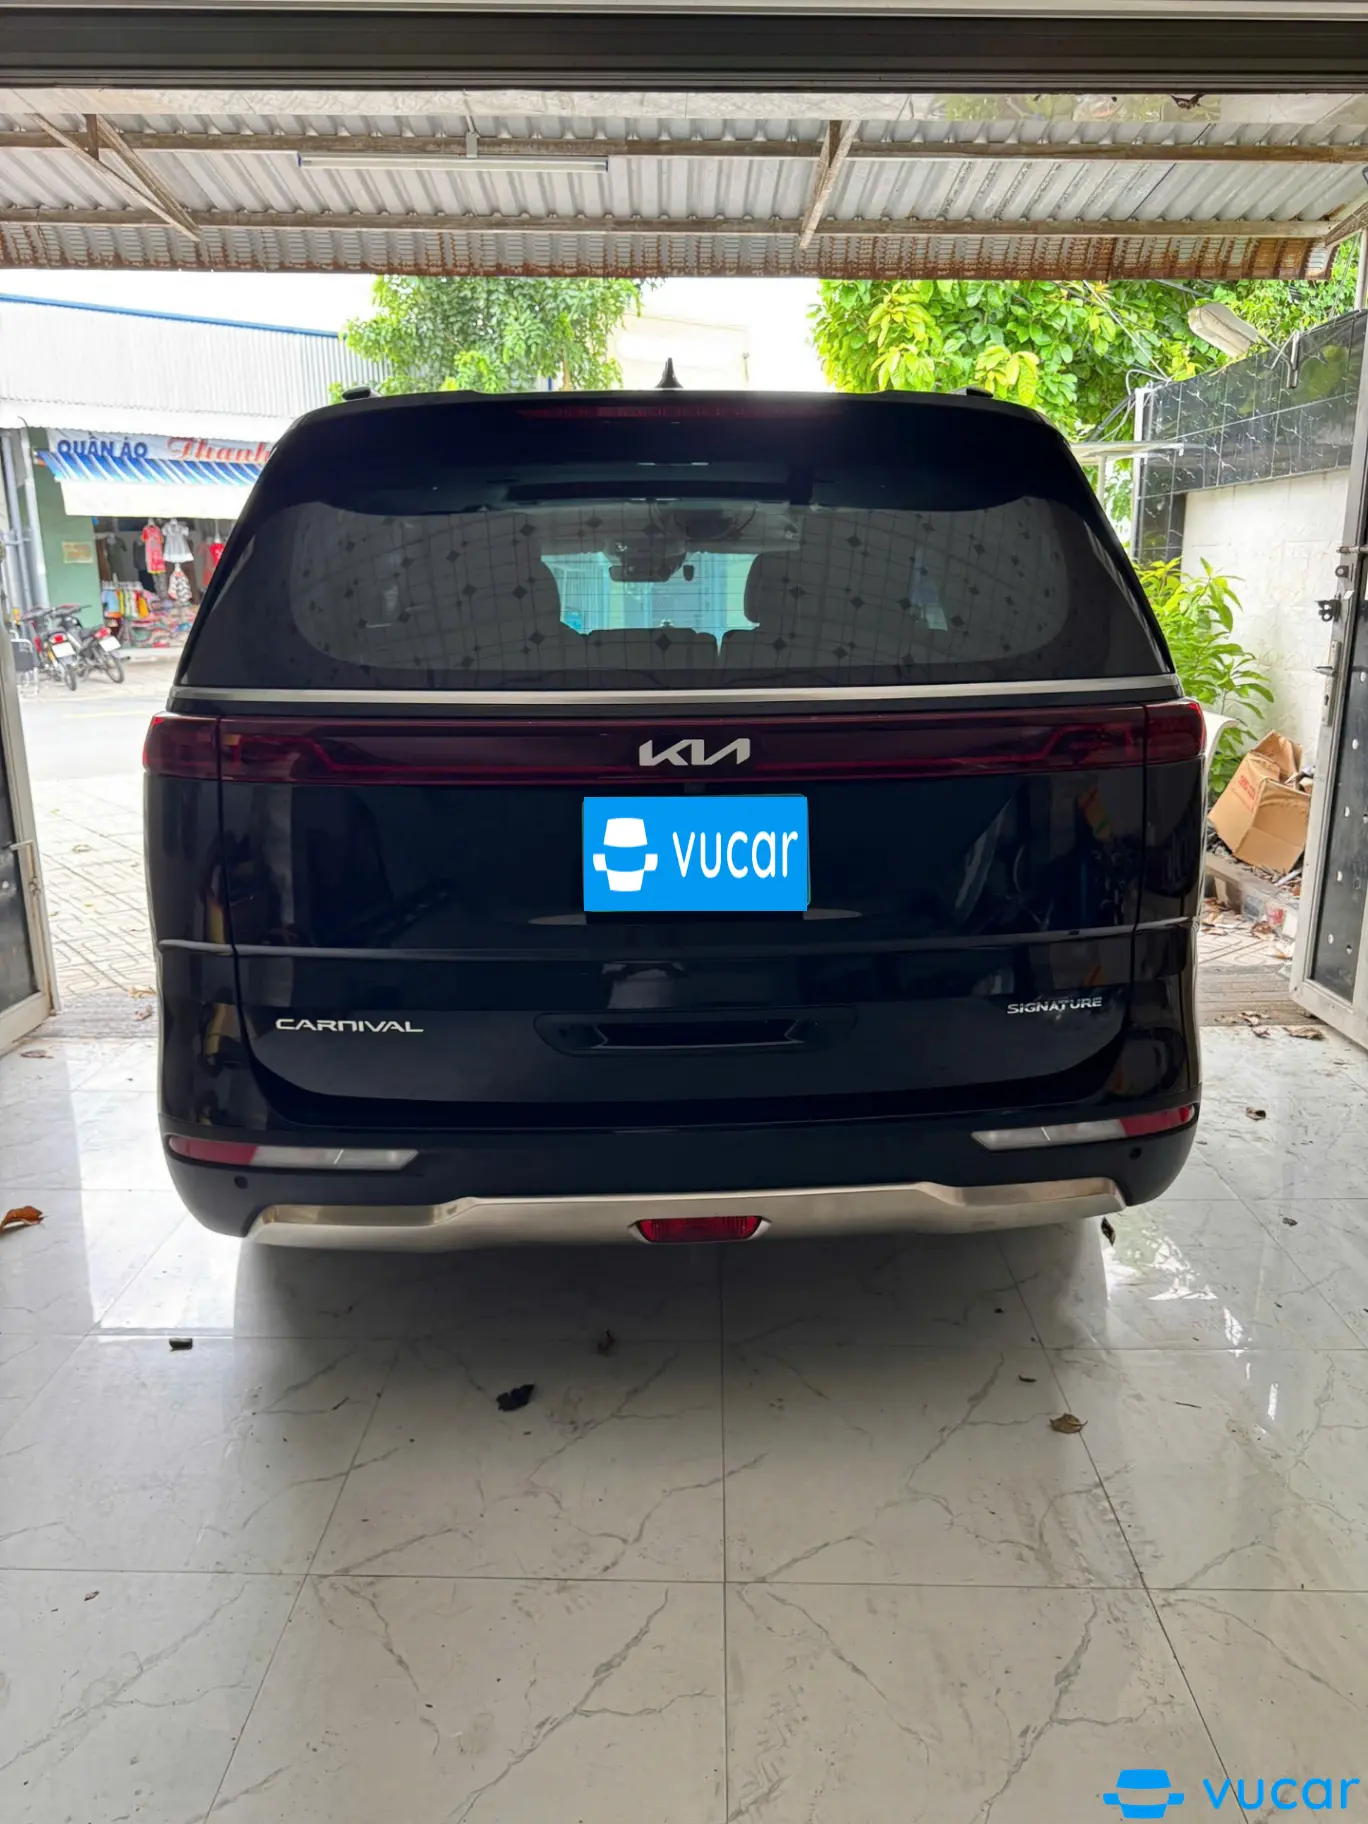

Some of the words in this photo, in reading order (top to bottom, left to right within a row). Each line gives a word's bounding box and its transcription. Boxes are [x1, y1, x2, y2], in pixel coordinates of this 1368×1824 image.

[638, 738, 751, 766] KIA
[1007, 997, 1103, 1014] SIGNATURE
[275, 1018, 425, 1033] CARNIVAL
